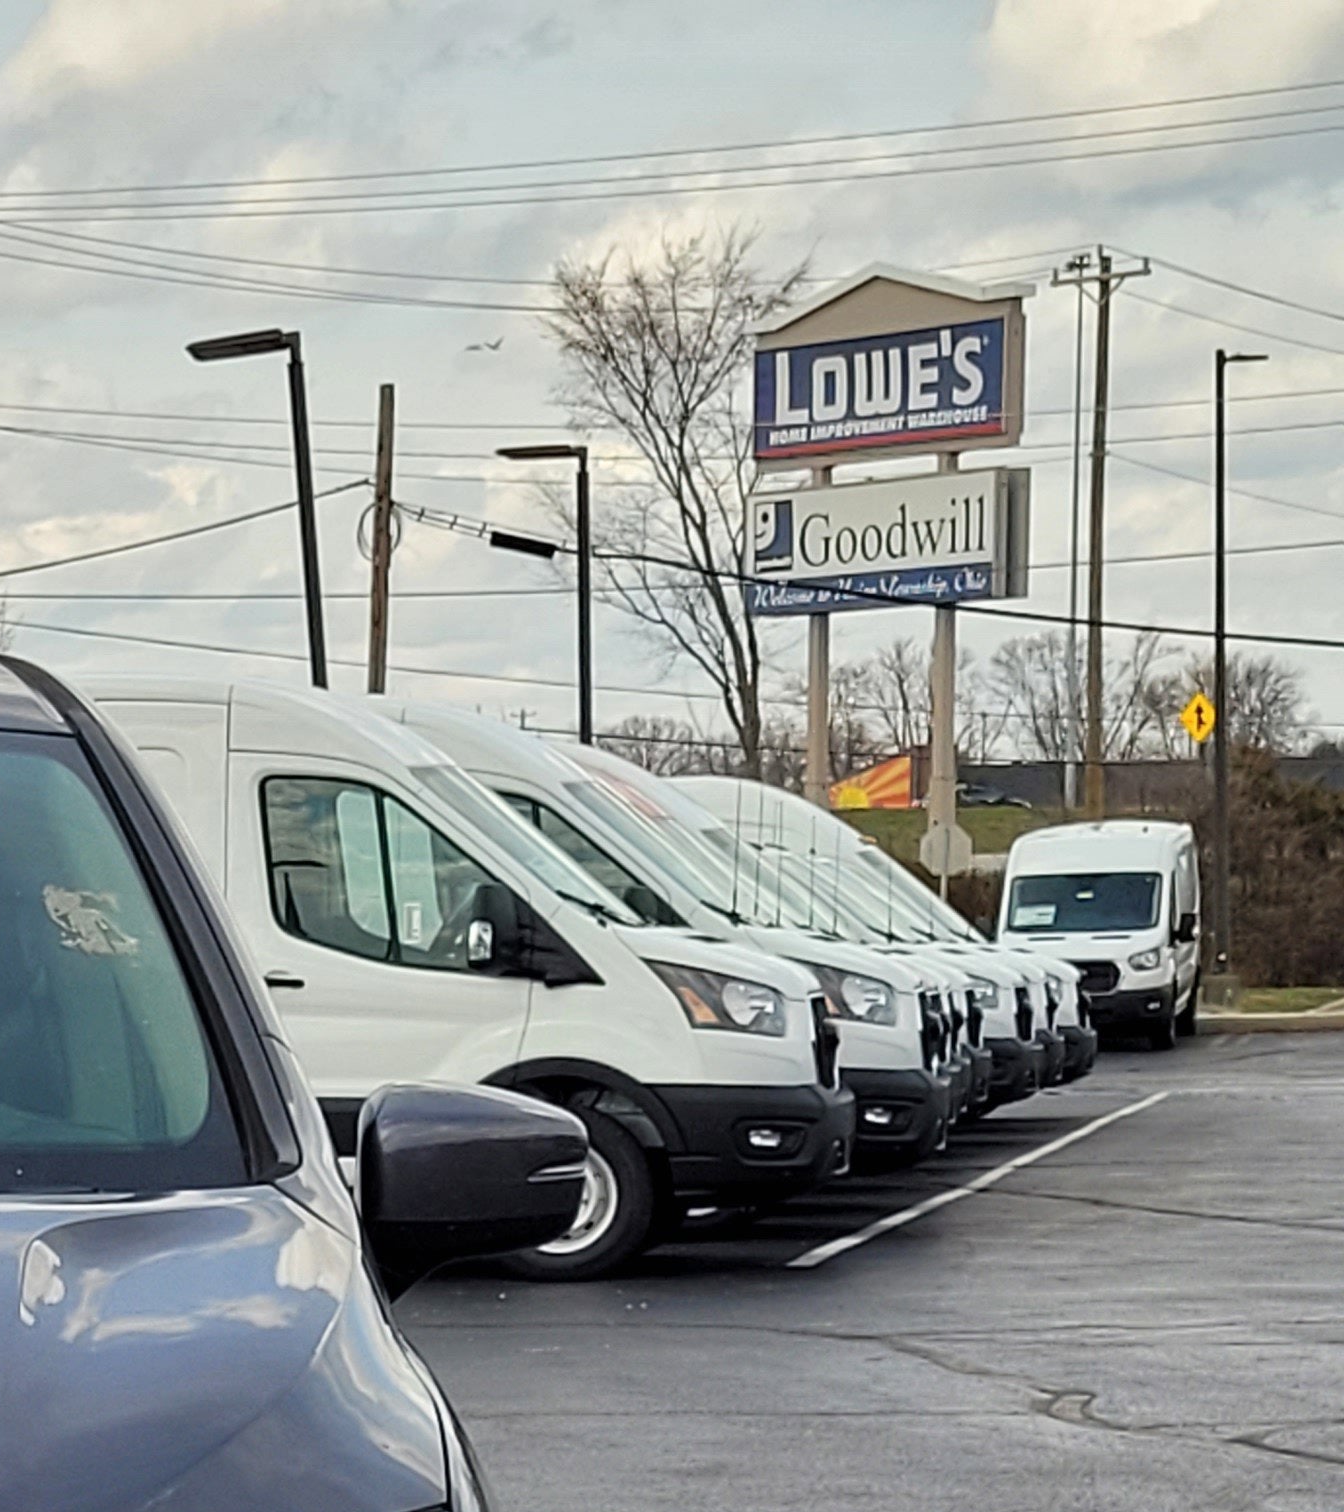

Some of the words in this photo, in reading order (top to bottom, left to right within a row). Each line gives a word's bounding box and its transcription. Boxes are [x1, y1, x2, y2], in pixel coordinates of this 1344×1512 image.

[774, 328, 985, 426] LOWE'S
[769, 427, 808, 446] HOME
[810, 415, 904, 441] IMPROVEMENT
[907, 405, 988, 430] WAREHOUSE
[798, 495, 985, 568] Goodwill
